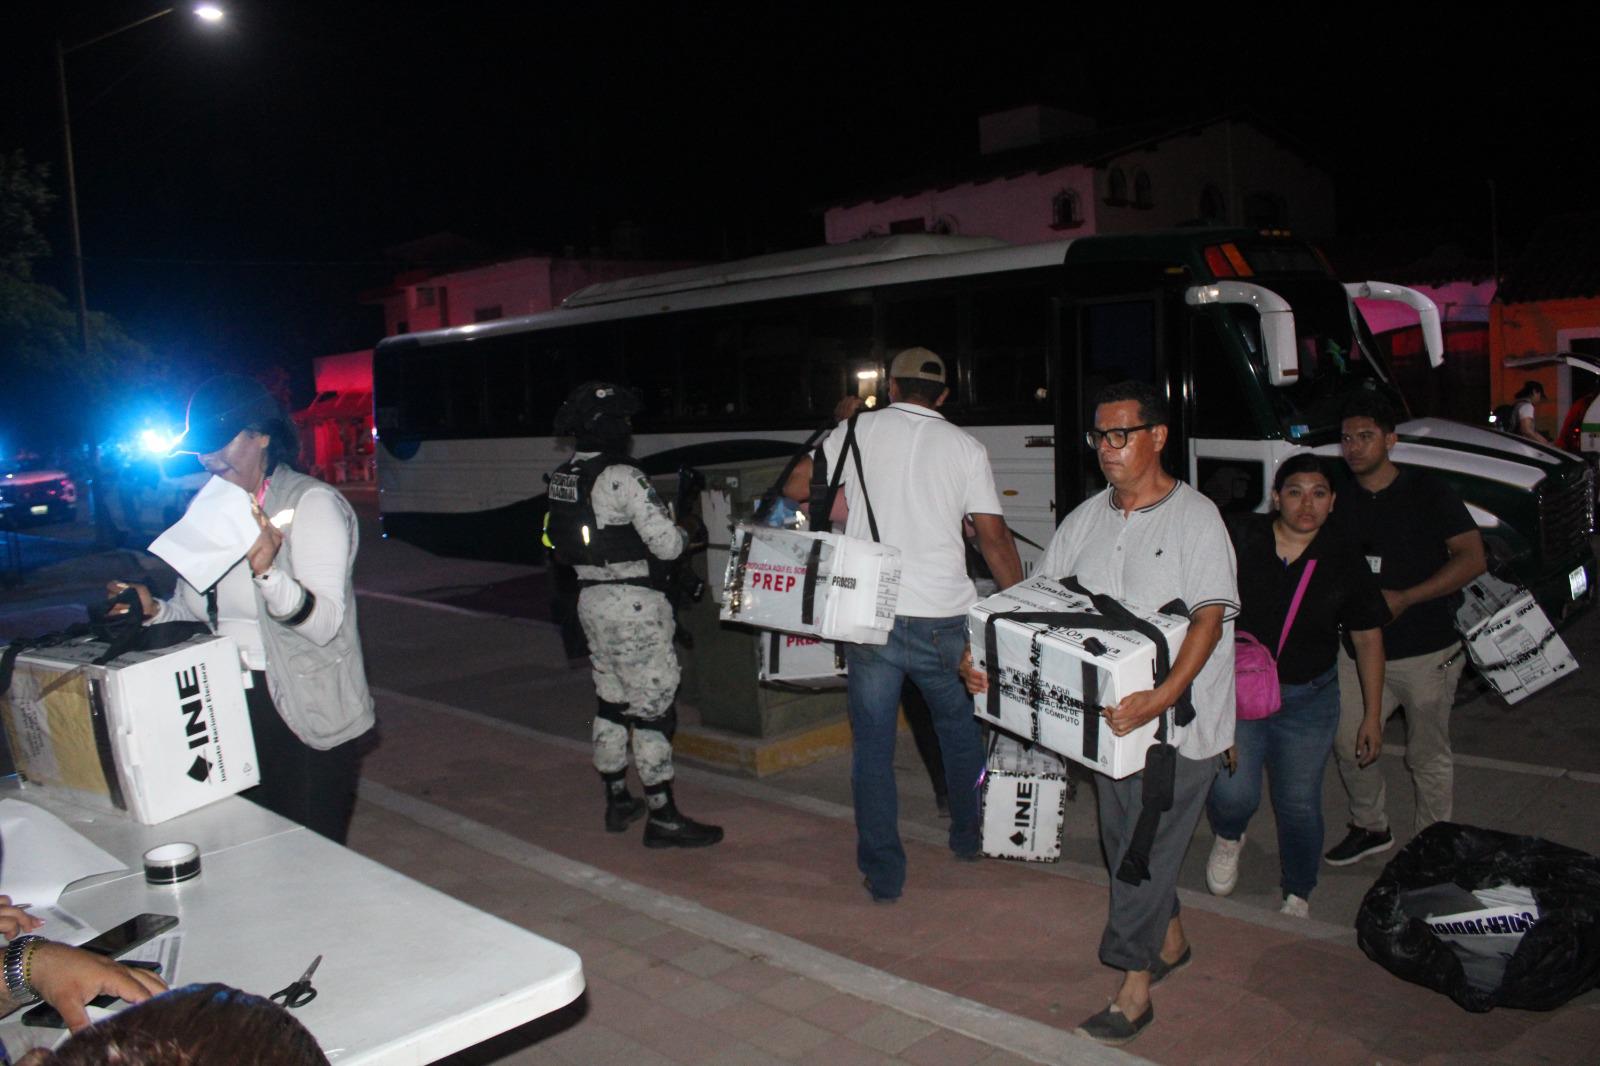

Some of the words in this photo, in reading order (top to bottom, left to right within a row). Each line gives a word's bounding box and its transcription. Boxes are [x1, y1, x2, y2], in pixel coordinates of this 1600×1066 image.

[751, 571, 797, 593] PREP
[200, 662, 212, 703] Electoral
[175, 665, 210, 750] INE
[206, 703, 219, 744] Nacional
[216, 744, 227, 783] Instituto
[1014, 782, 1033, 828] INE
